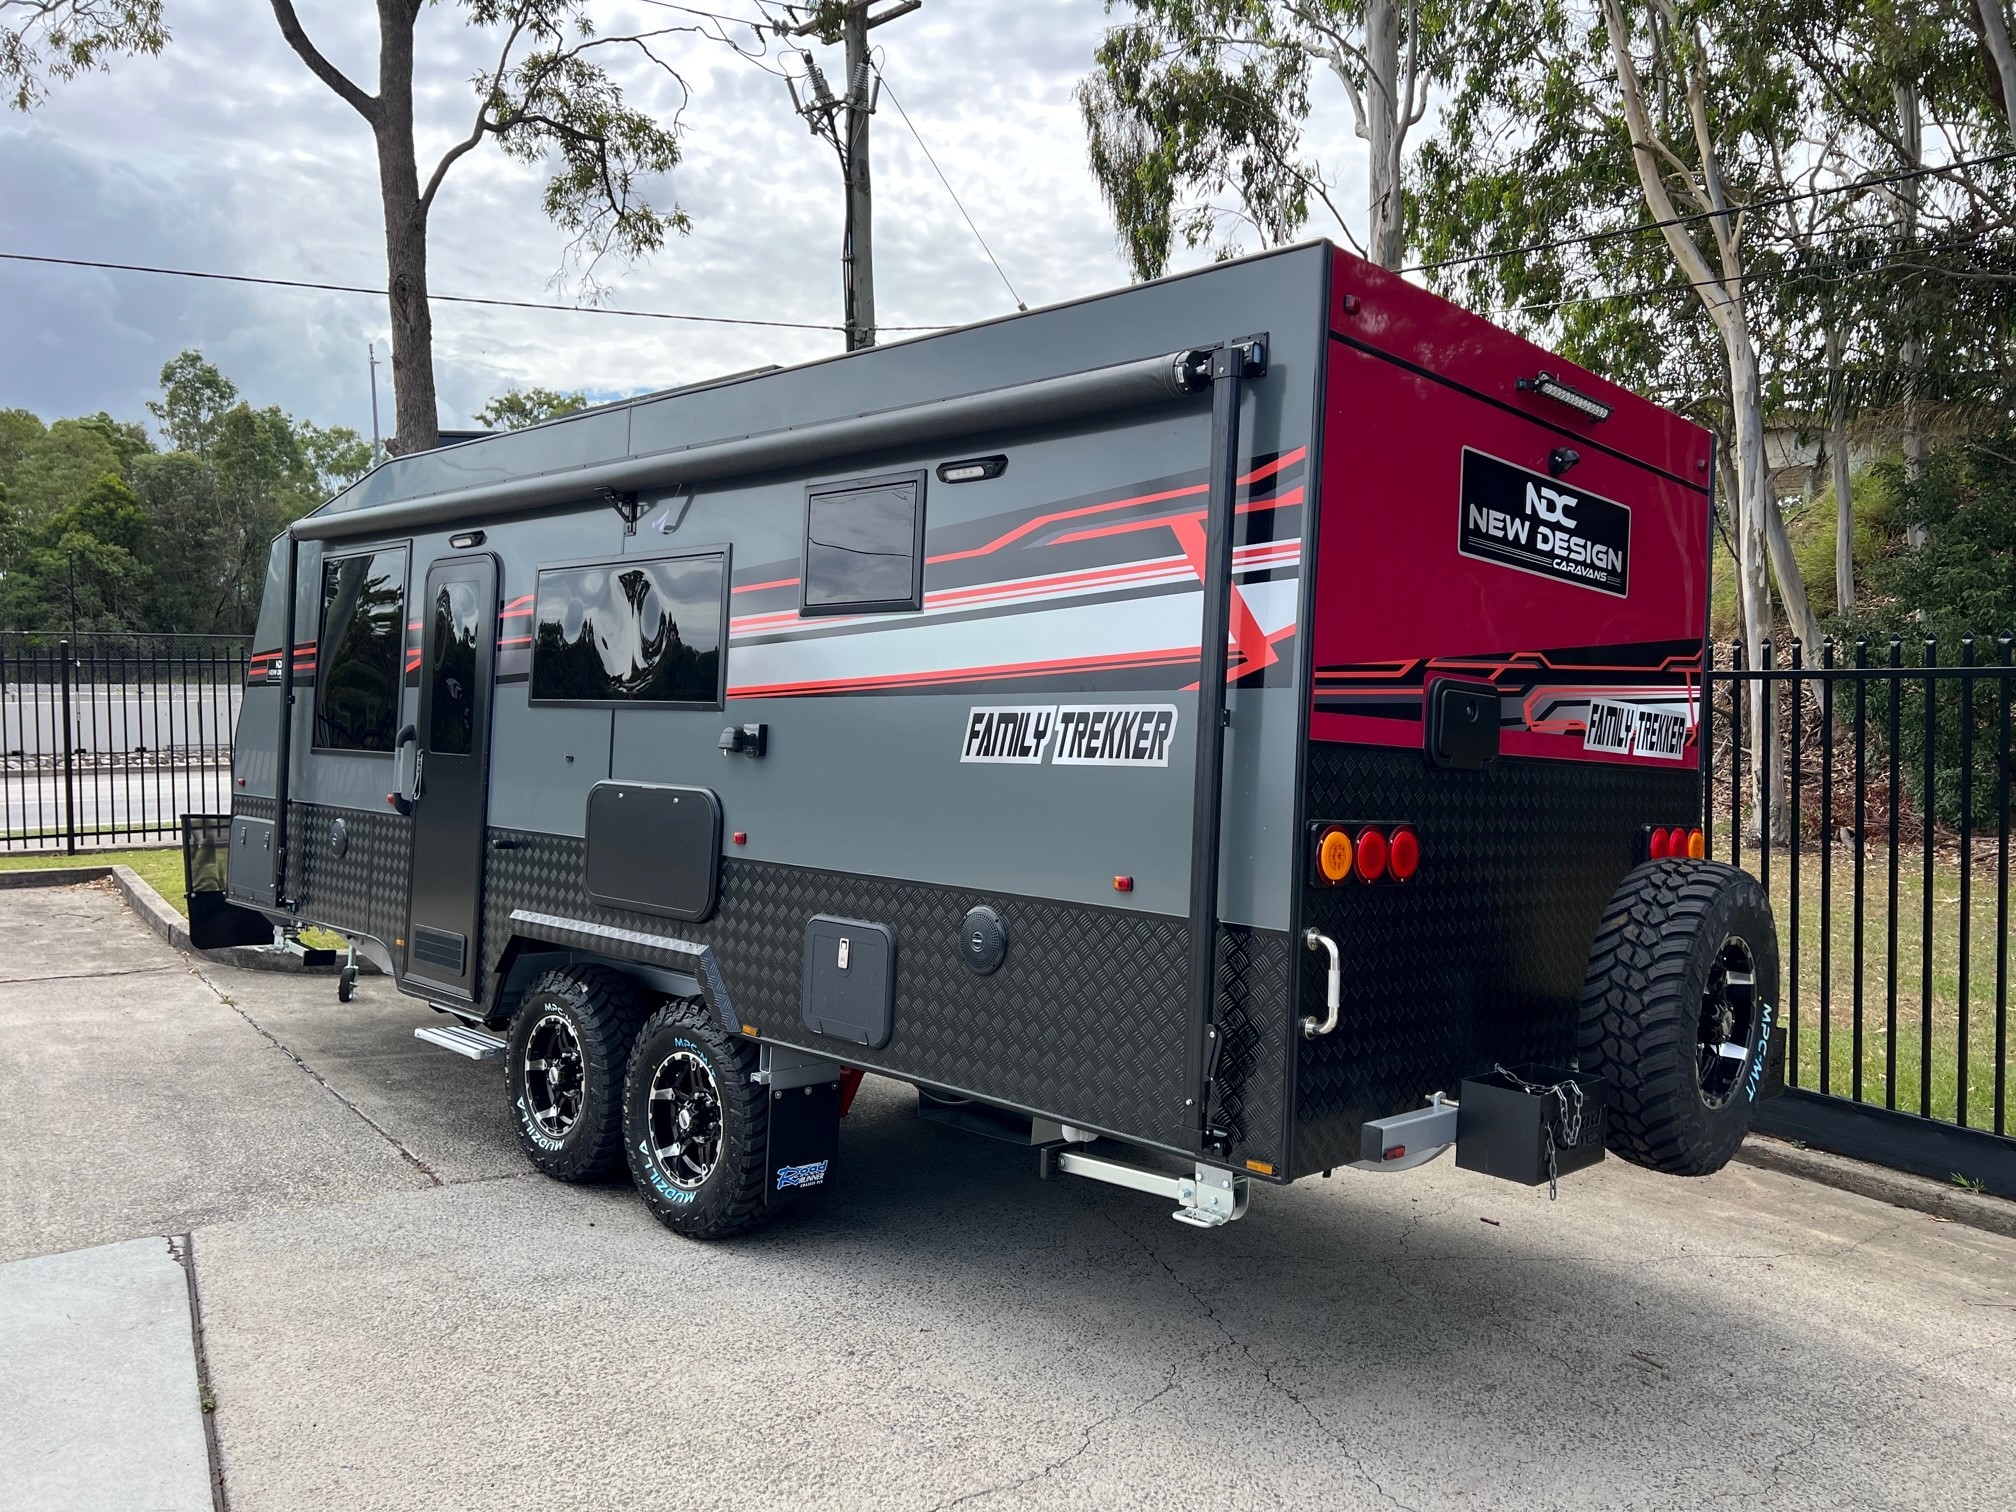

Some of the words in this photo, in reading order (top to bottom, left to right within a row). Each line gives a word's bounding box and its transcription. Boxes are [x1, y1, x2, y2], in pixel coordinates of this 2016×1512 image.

[1525, 482, 1578, 528] NDC
[1468, 503, 1530, 545] NEW
[1536, 526, 1623, 573] DESIGN
[1552, 558, 1608, 582] CARAVANS
[965, 712, 1052, 758] FAMILY
[1057, 711, 1173, 760] TREKKER
[1586, 703, 1635, 748] FAMILY
[1636, 711, 1686, 755] TREKKER
[1746, 1003, 1773, 1104] MPC-M/T
[516, 1096, 565, 1152] MUDZILLA
[638, 1139, 697, 1205] MUDZILLA
